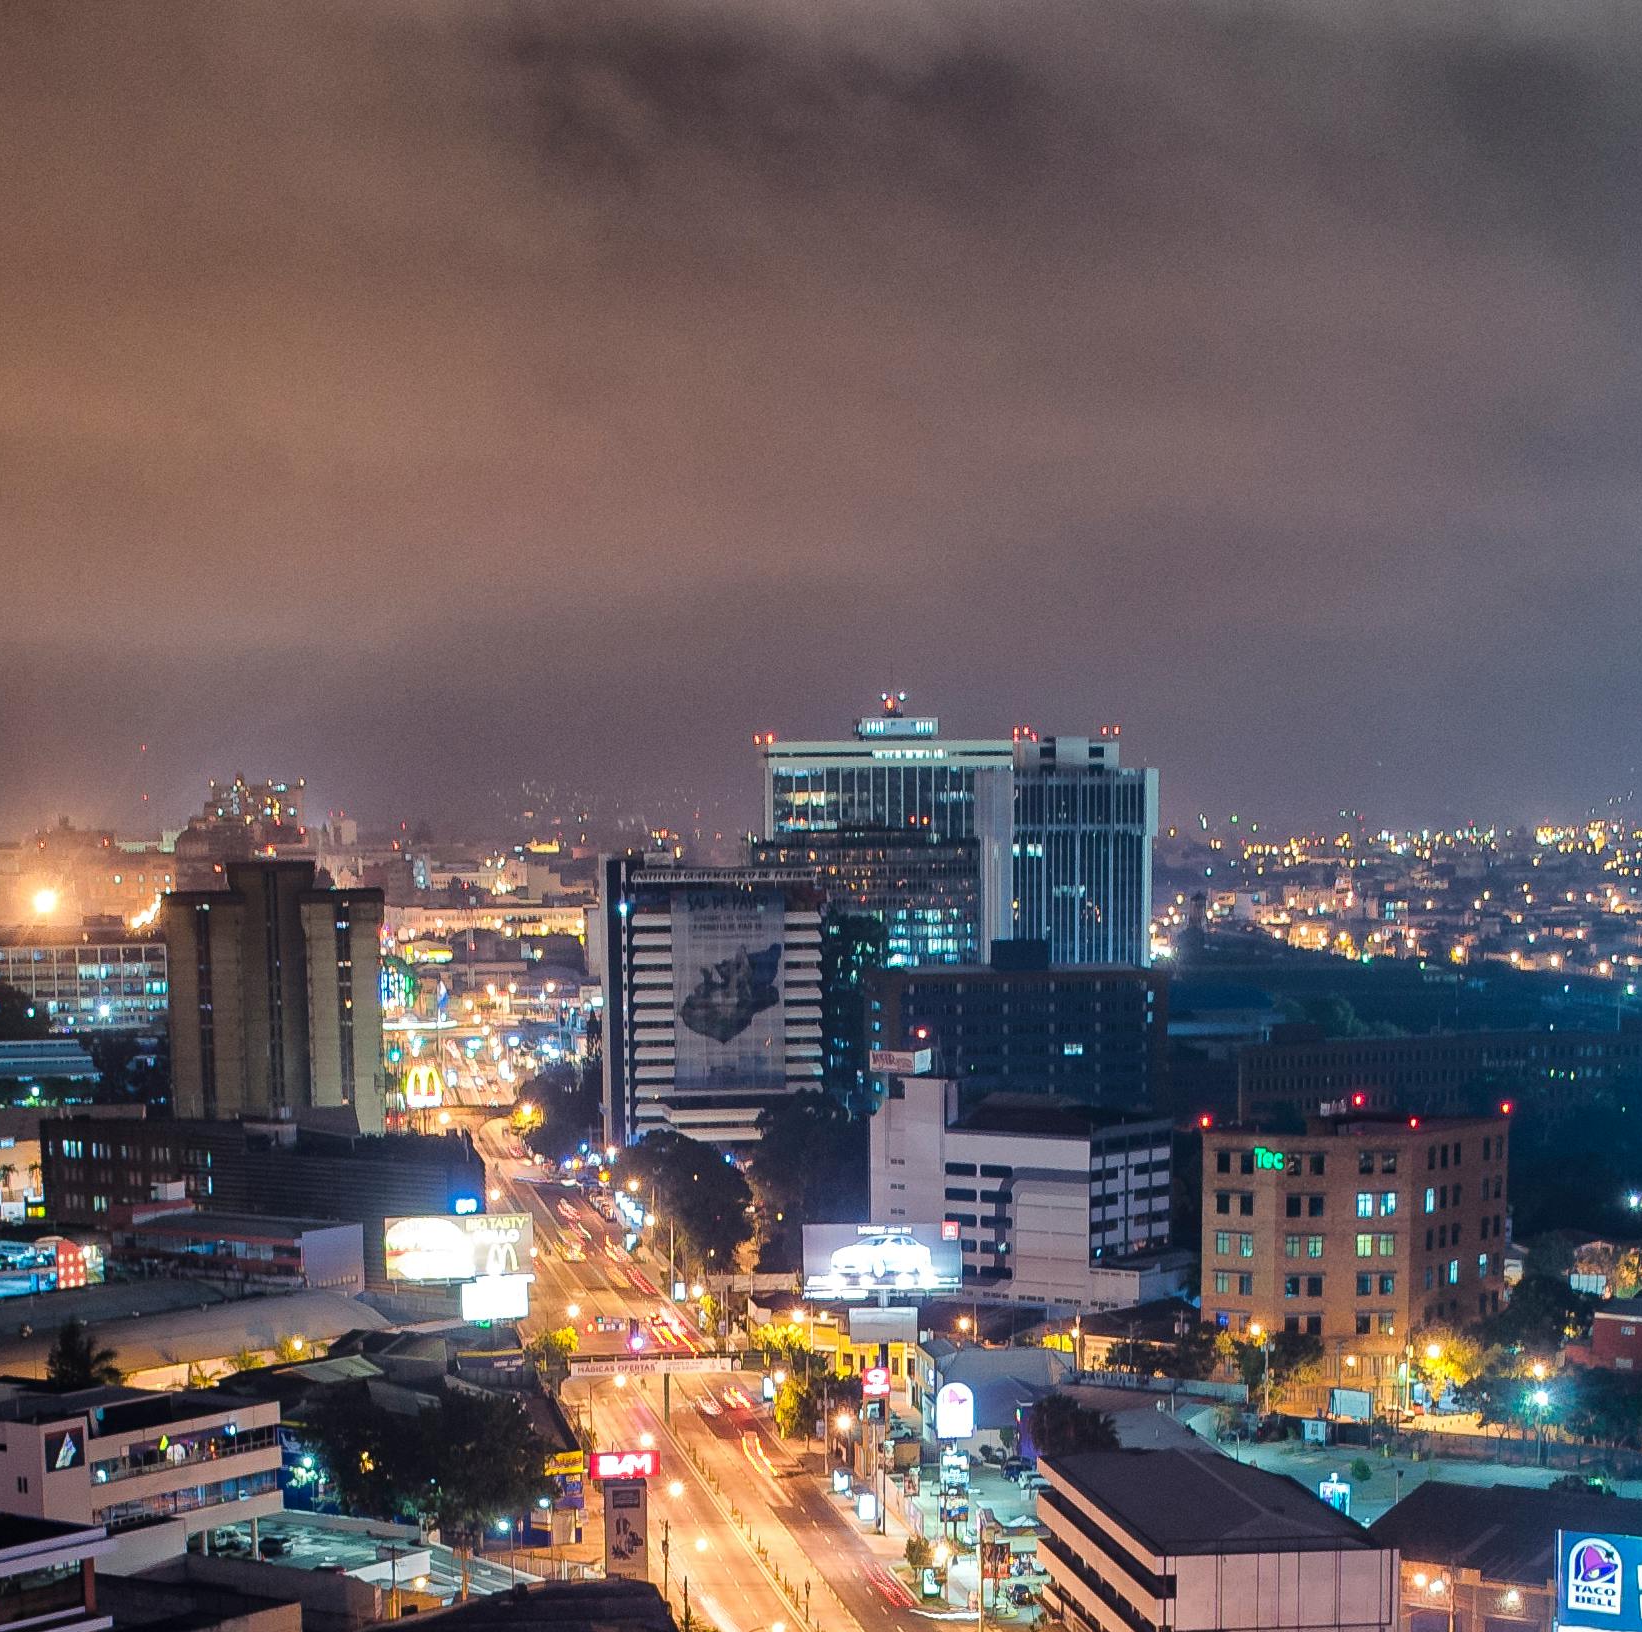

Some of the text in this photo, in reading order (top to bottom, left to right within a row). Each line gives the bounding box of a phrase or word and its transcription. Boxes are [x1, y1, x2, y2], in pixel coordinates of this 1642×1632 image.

[632, 870, 683, 881] INSTITUTO
[1254, 1146, 1285, 1171] Tec
[488, 1216, 525, 1230] TASTY
[1572, 1583, 1617, 1598] TACO
[1574, 1595, 1617, 1608] BELL
